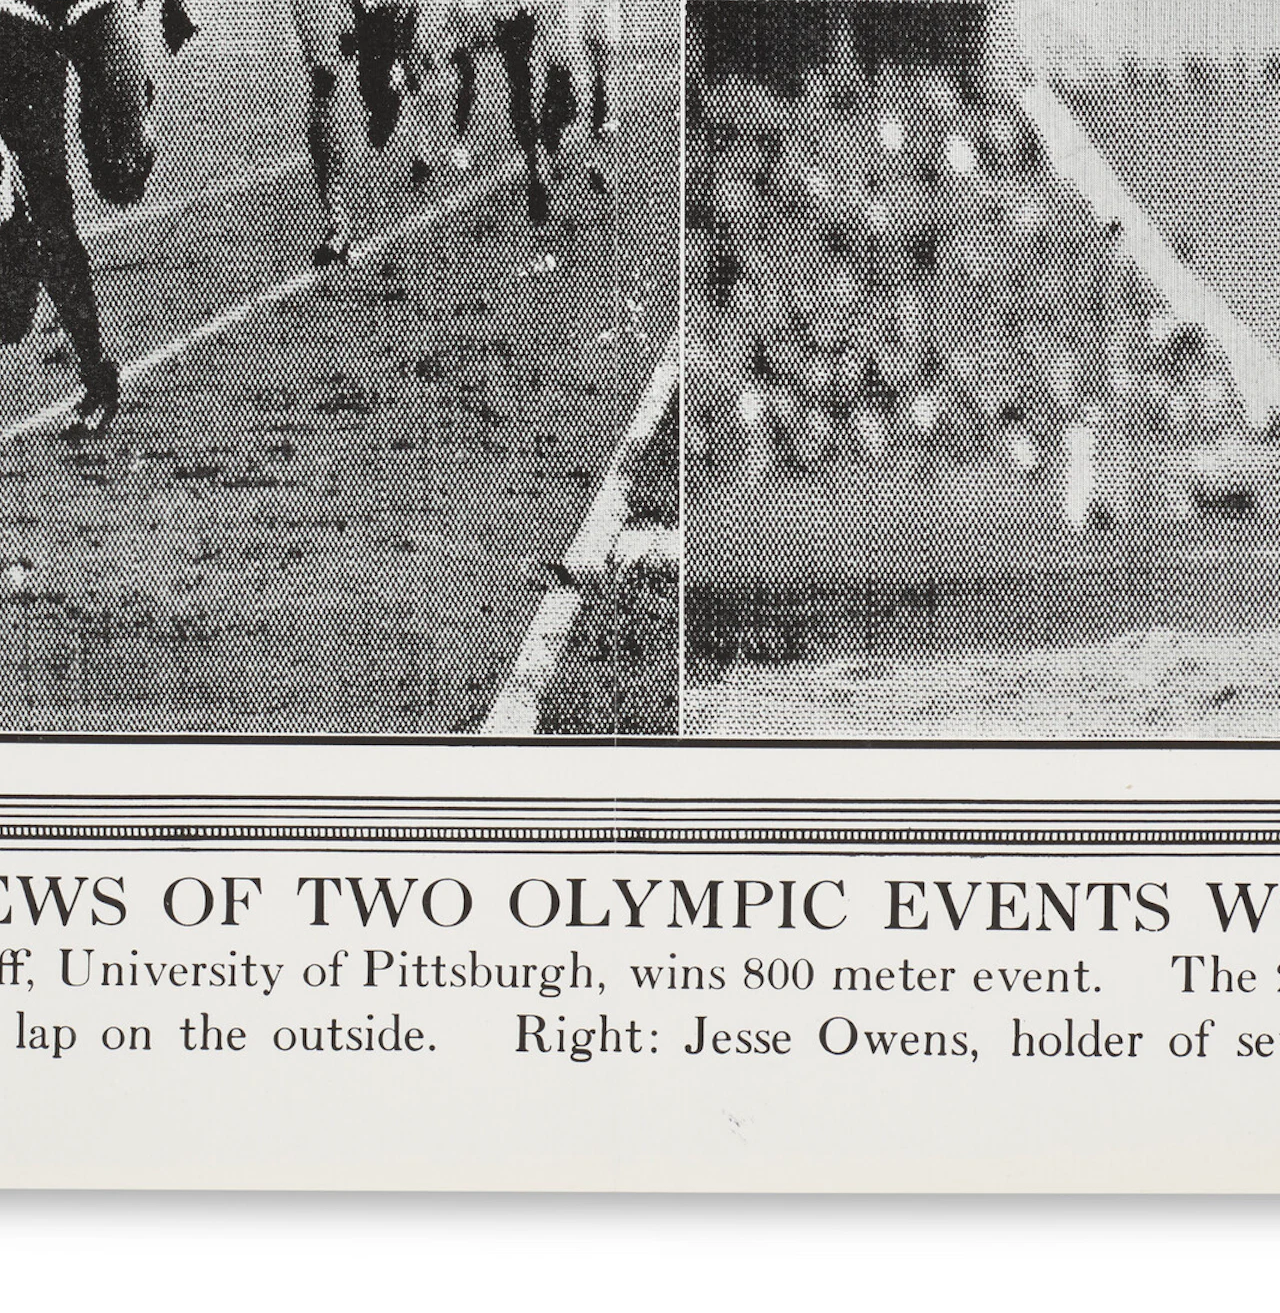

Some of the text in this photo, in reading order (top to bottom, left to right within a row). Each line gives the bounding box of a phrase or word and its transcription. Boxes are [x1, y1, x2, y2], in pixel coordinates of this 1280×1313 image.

[163, 877, 262, 927] OF
[296, 877, 473, 928] TWO
[509, 878, 847, 930] OLYMPIC
[884, 880, 1170, 932] EVENTS
[59, 948, 284, 996] University
[302, 950, 349, 987] of
[363, 949, 605, 998] Pittsburgh,
[630, 952, 726, 990] wins
[743, 957, 814, 990] 800
[832, 959, 956, 992] meter
[973, 960, 1101, 993] event.
[1171, 954, 1257, 993] The
[15, 1010, 77, 1059] lap
[101, 1026, 152, 1051] on
[179, 1012, 246, 1051] the
[273, 1013, 436, 1052] outside.
[515, 1014, 658, 1063] Right:
[684, 1016, 791, 1055] Jesse
[818, 1016, 978, 1063] Owens,
[1011, 1018, 1144, 1058] holder
[1169, 1018, 1216, 1058] of
